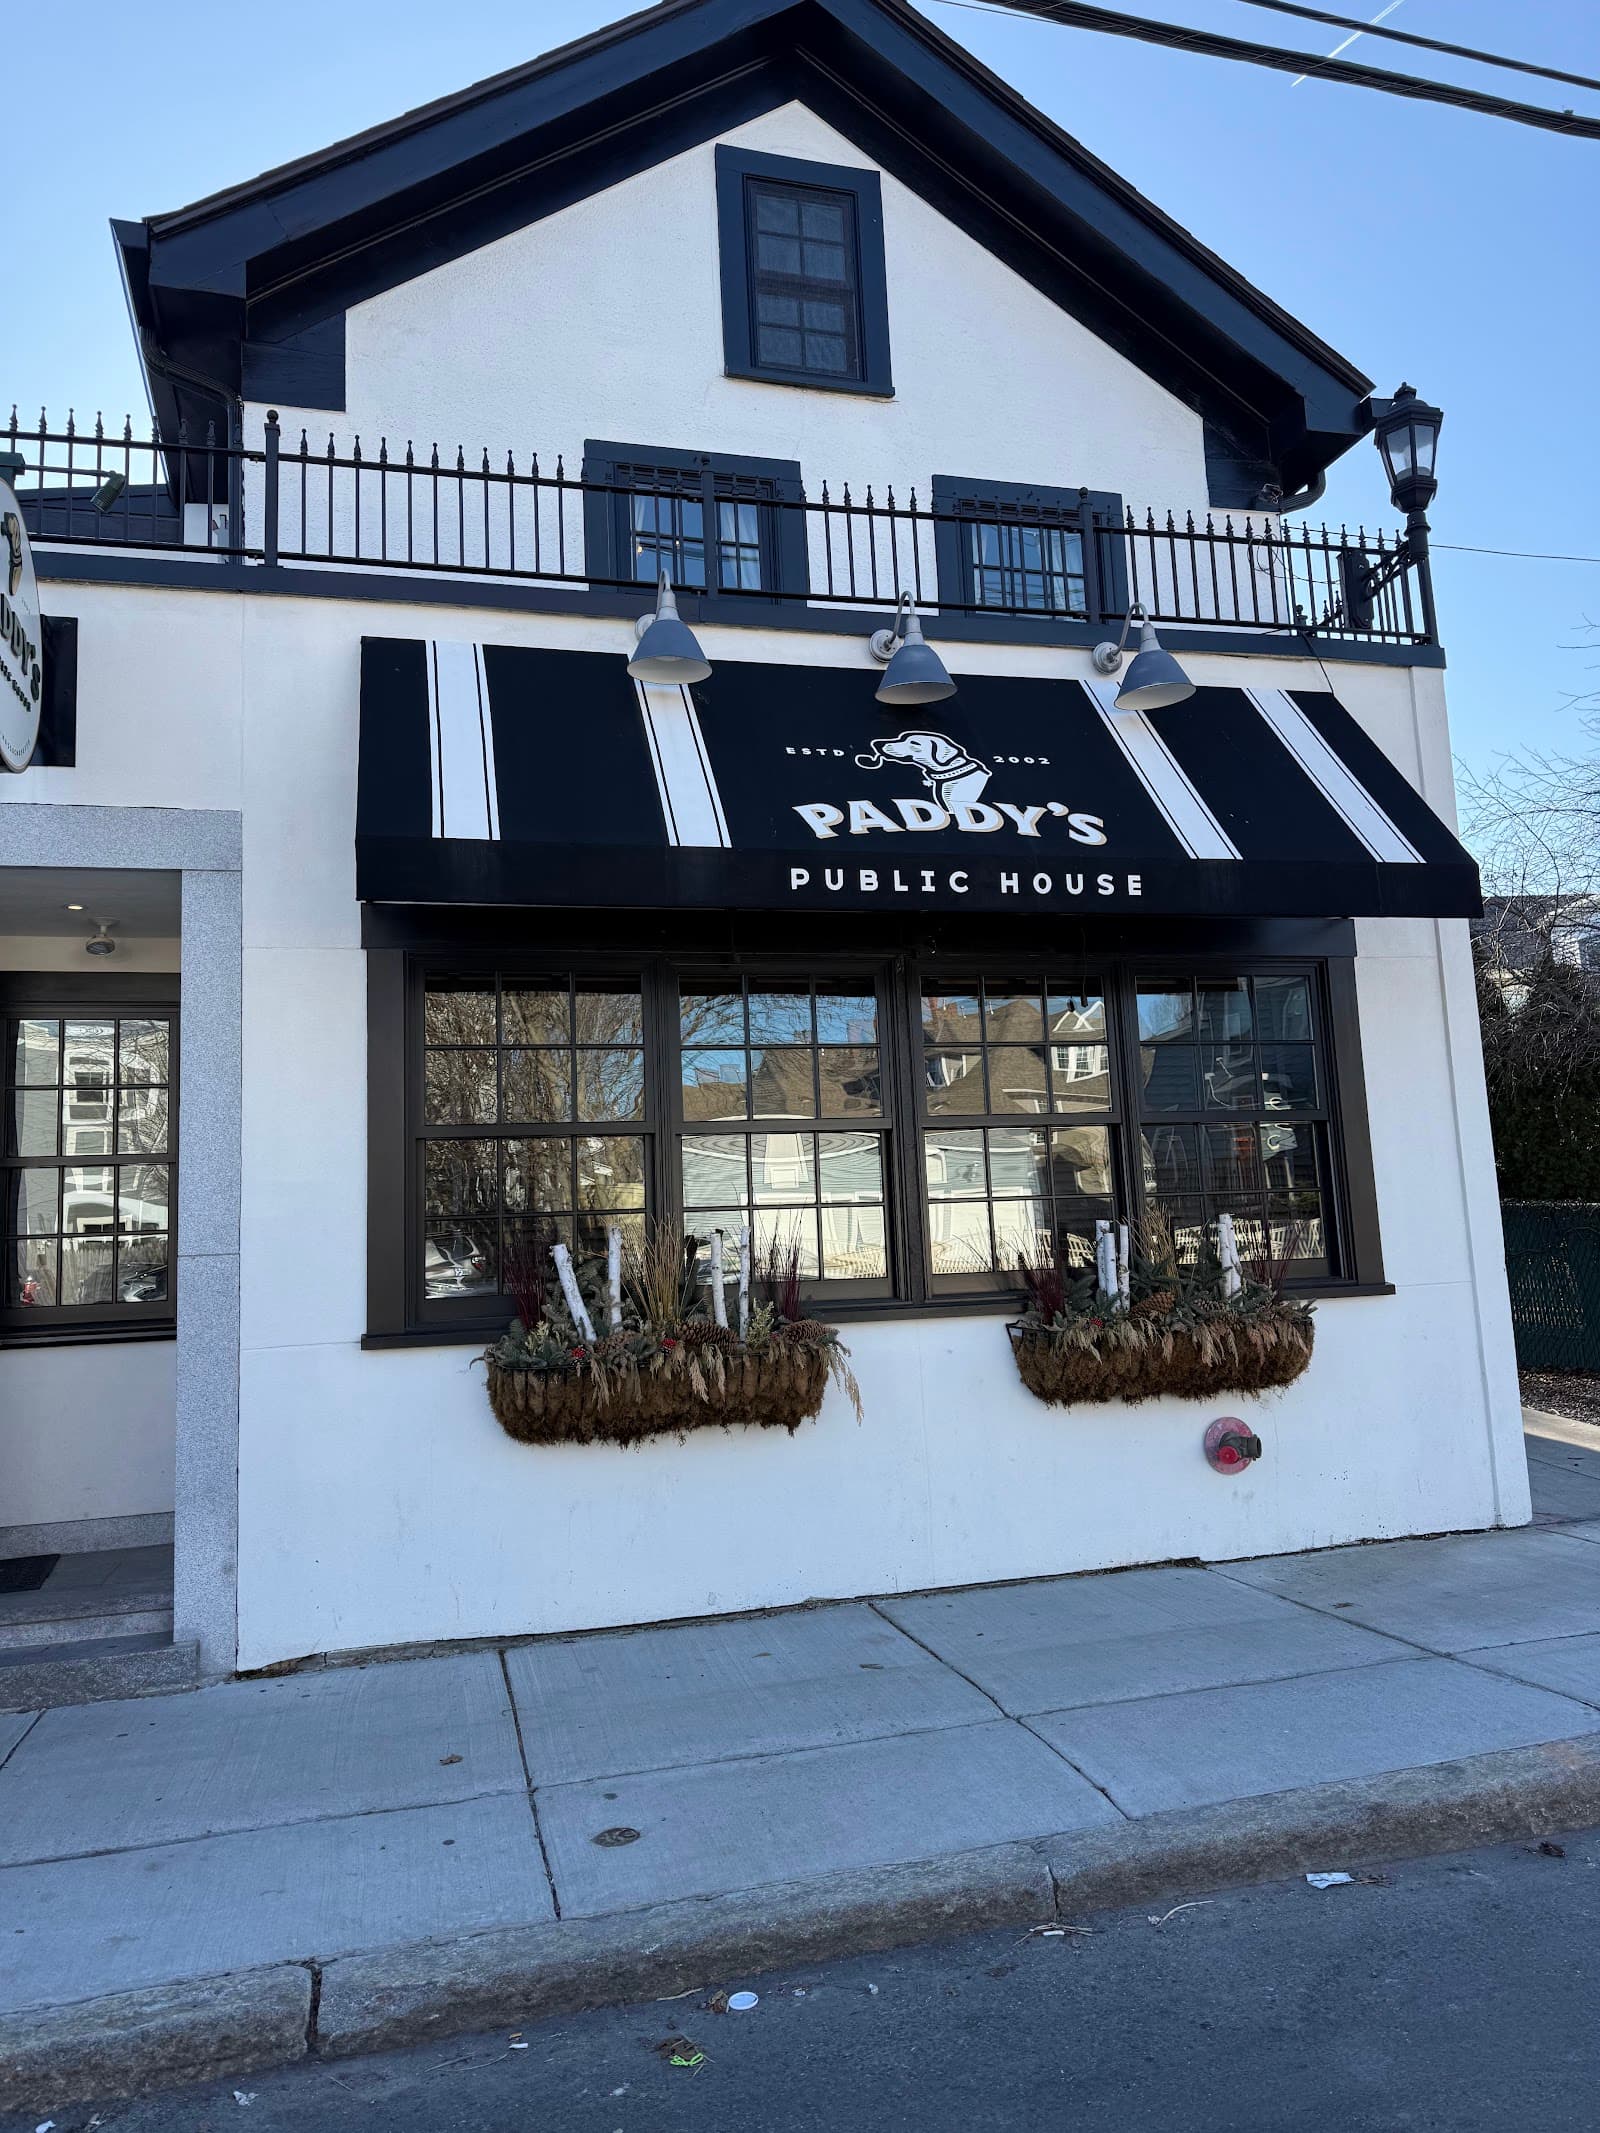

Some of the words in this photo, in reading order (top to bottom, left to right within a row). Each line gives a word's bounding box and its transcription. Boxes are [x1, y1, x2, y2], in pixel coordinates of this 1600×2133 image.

[785, 746, 845, 757] ESTD
[992, 755, 1051, 765] 2002
[792, 798, 1108, 846] PADDY'S
[790, 867, 969, 894] PUBLIC
[1000, 871, 1142, 896] HOUSE
